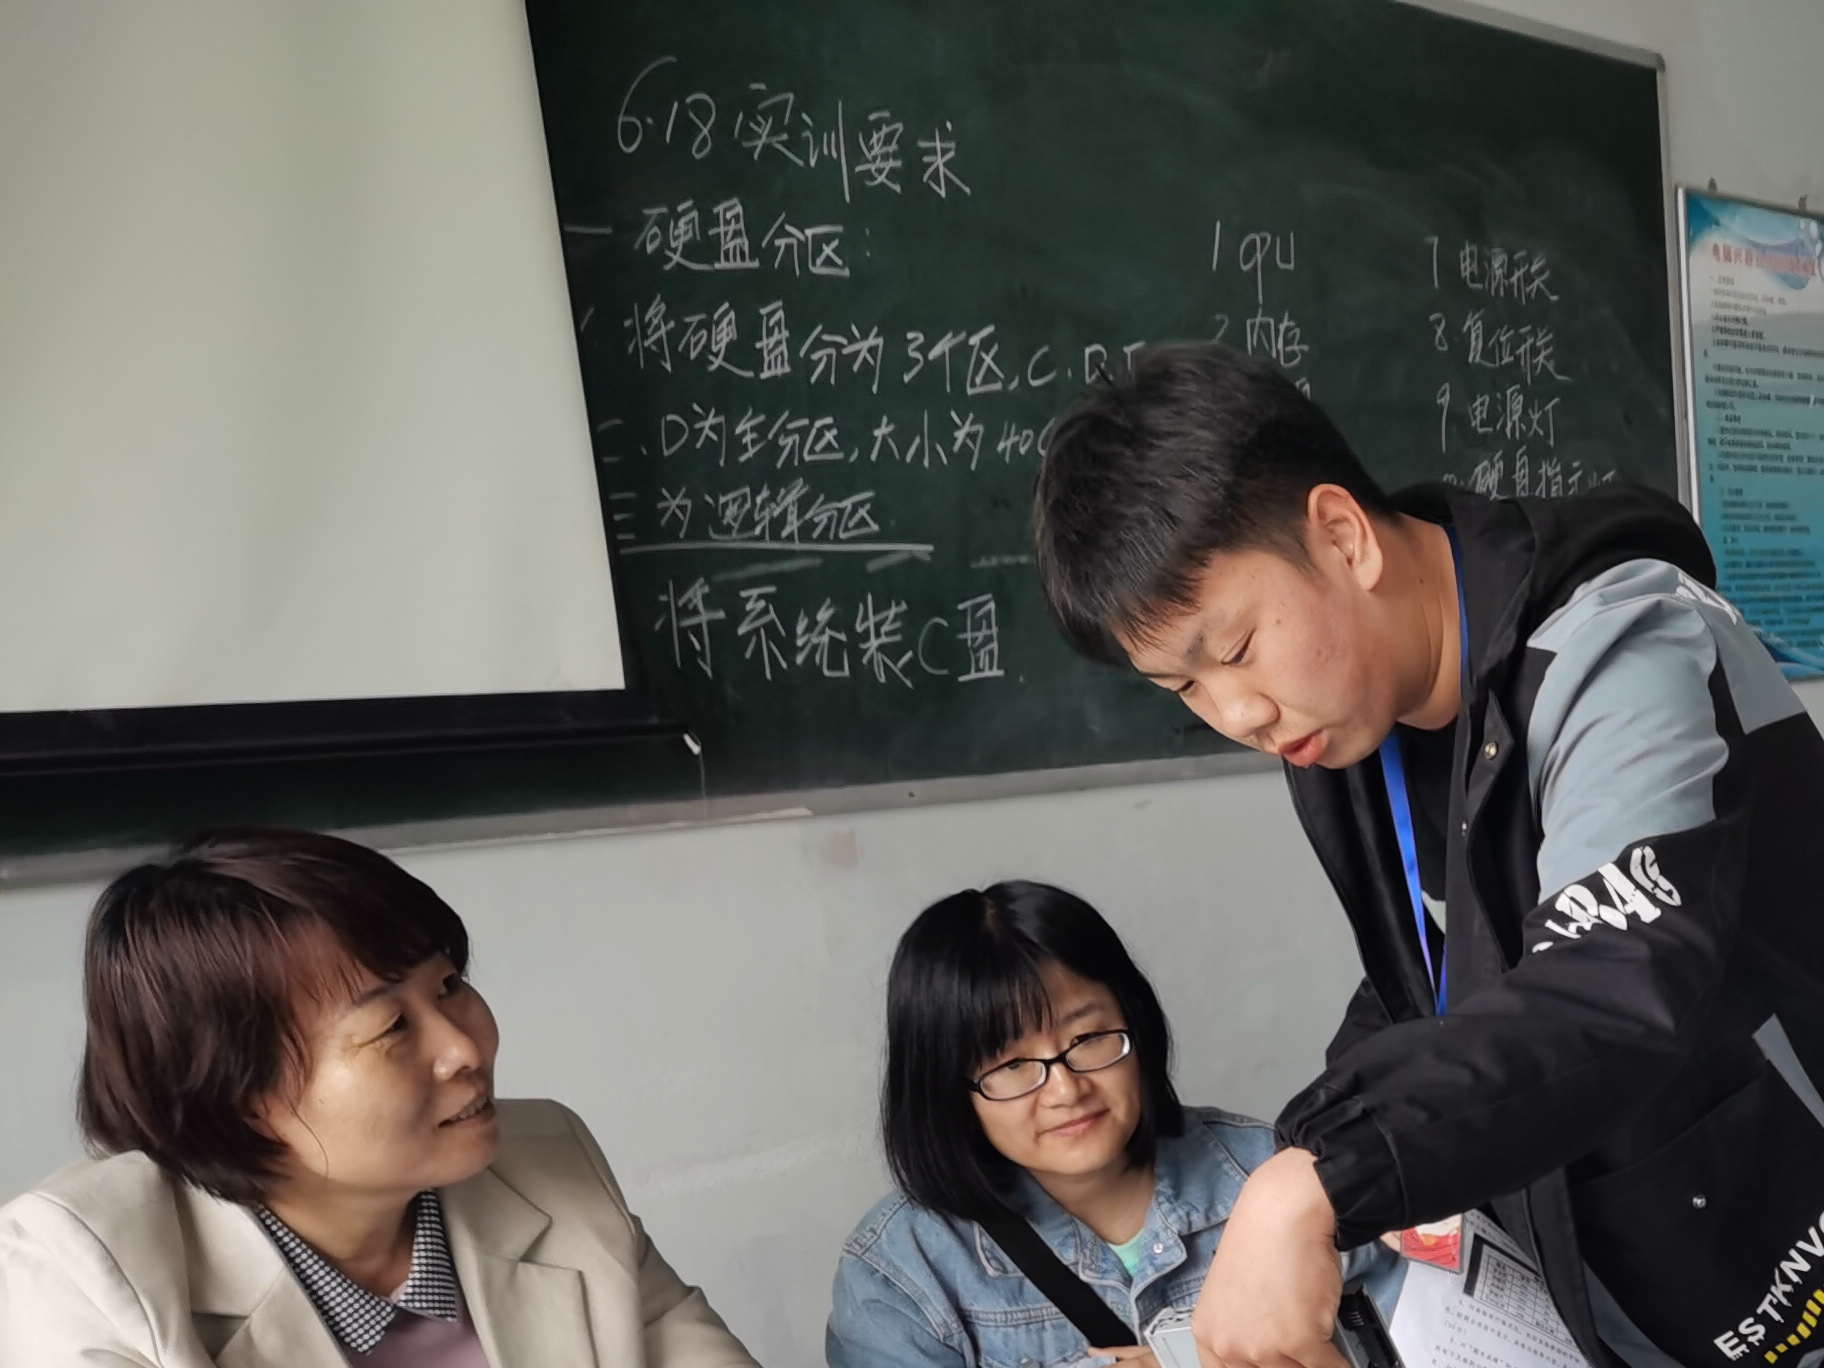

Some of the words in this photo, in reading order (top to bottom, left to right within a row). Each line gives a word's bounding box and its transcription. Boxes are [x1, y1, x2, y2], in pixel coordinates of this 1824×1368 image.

[1212, 220, 1221, 271] 1
[1467, 383, 1561, 448] 电源灯
